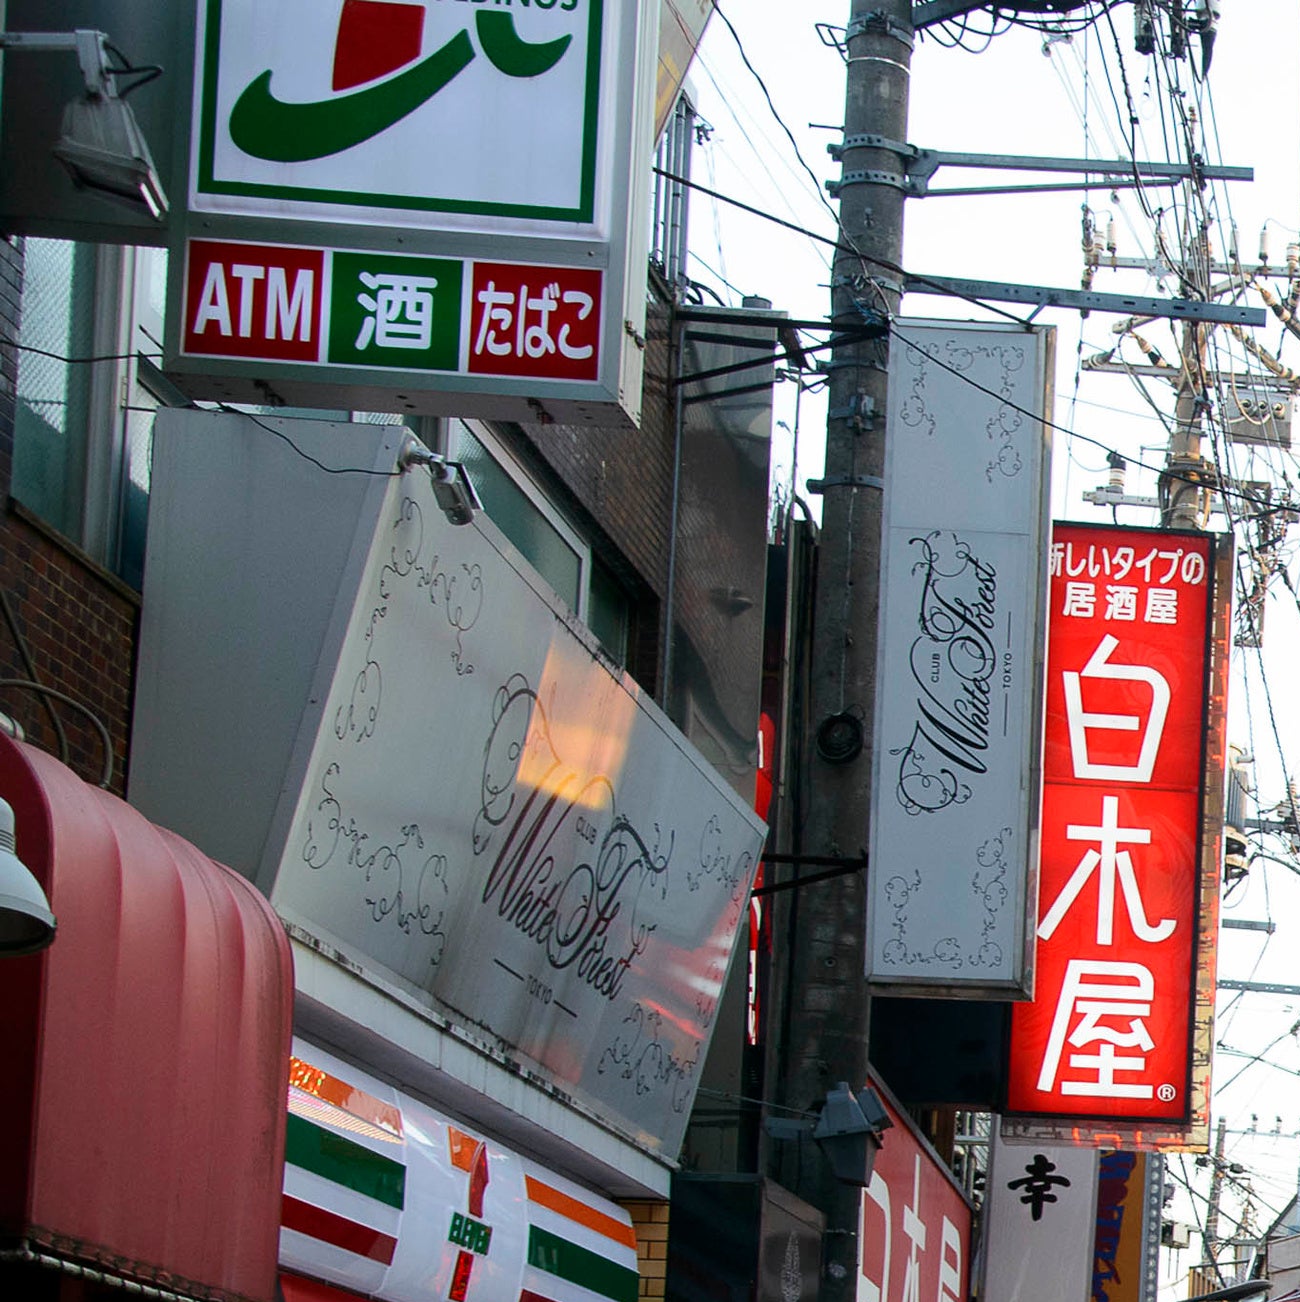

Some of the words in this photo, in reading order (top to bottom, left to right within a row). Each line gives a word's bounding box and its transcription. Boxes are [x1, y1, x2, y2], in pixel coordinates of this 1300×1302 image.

[193, 262, 315, 342] ATM
[355, 271, 438, 350] 酒
[475, 281, 594, 360] たばこ
[1047, 541, 1206, 586] 新しいタイプの
[1062, 582, 1178, 625] 居酒屋
[909, 652, 922, 683] CLUB
[1002, 652, 1013, 689] TOKYO
[1035, 633, 1176, 1100] 白木屋
